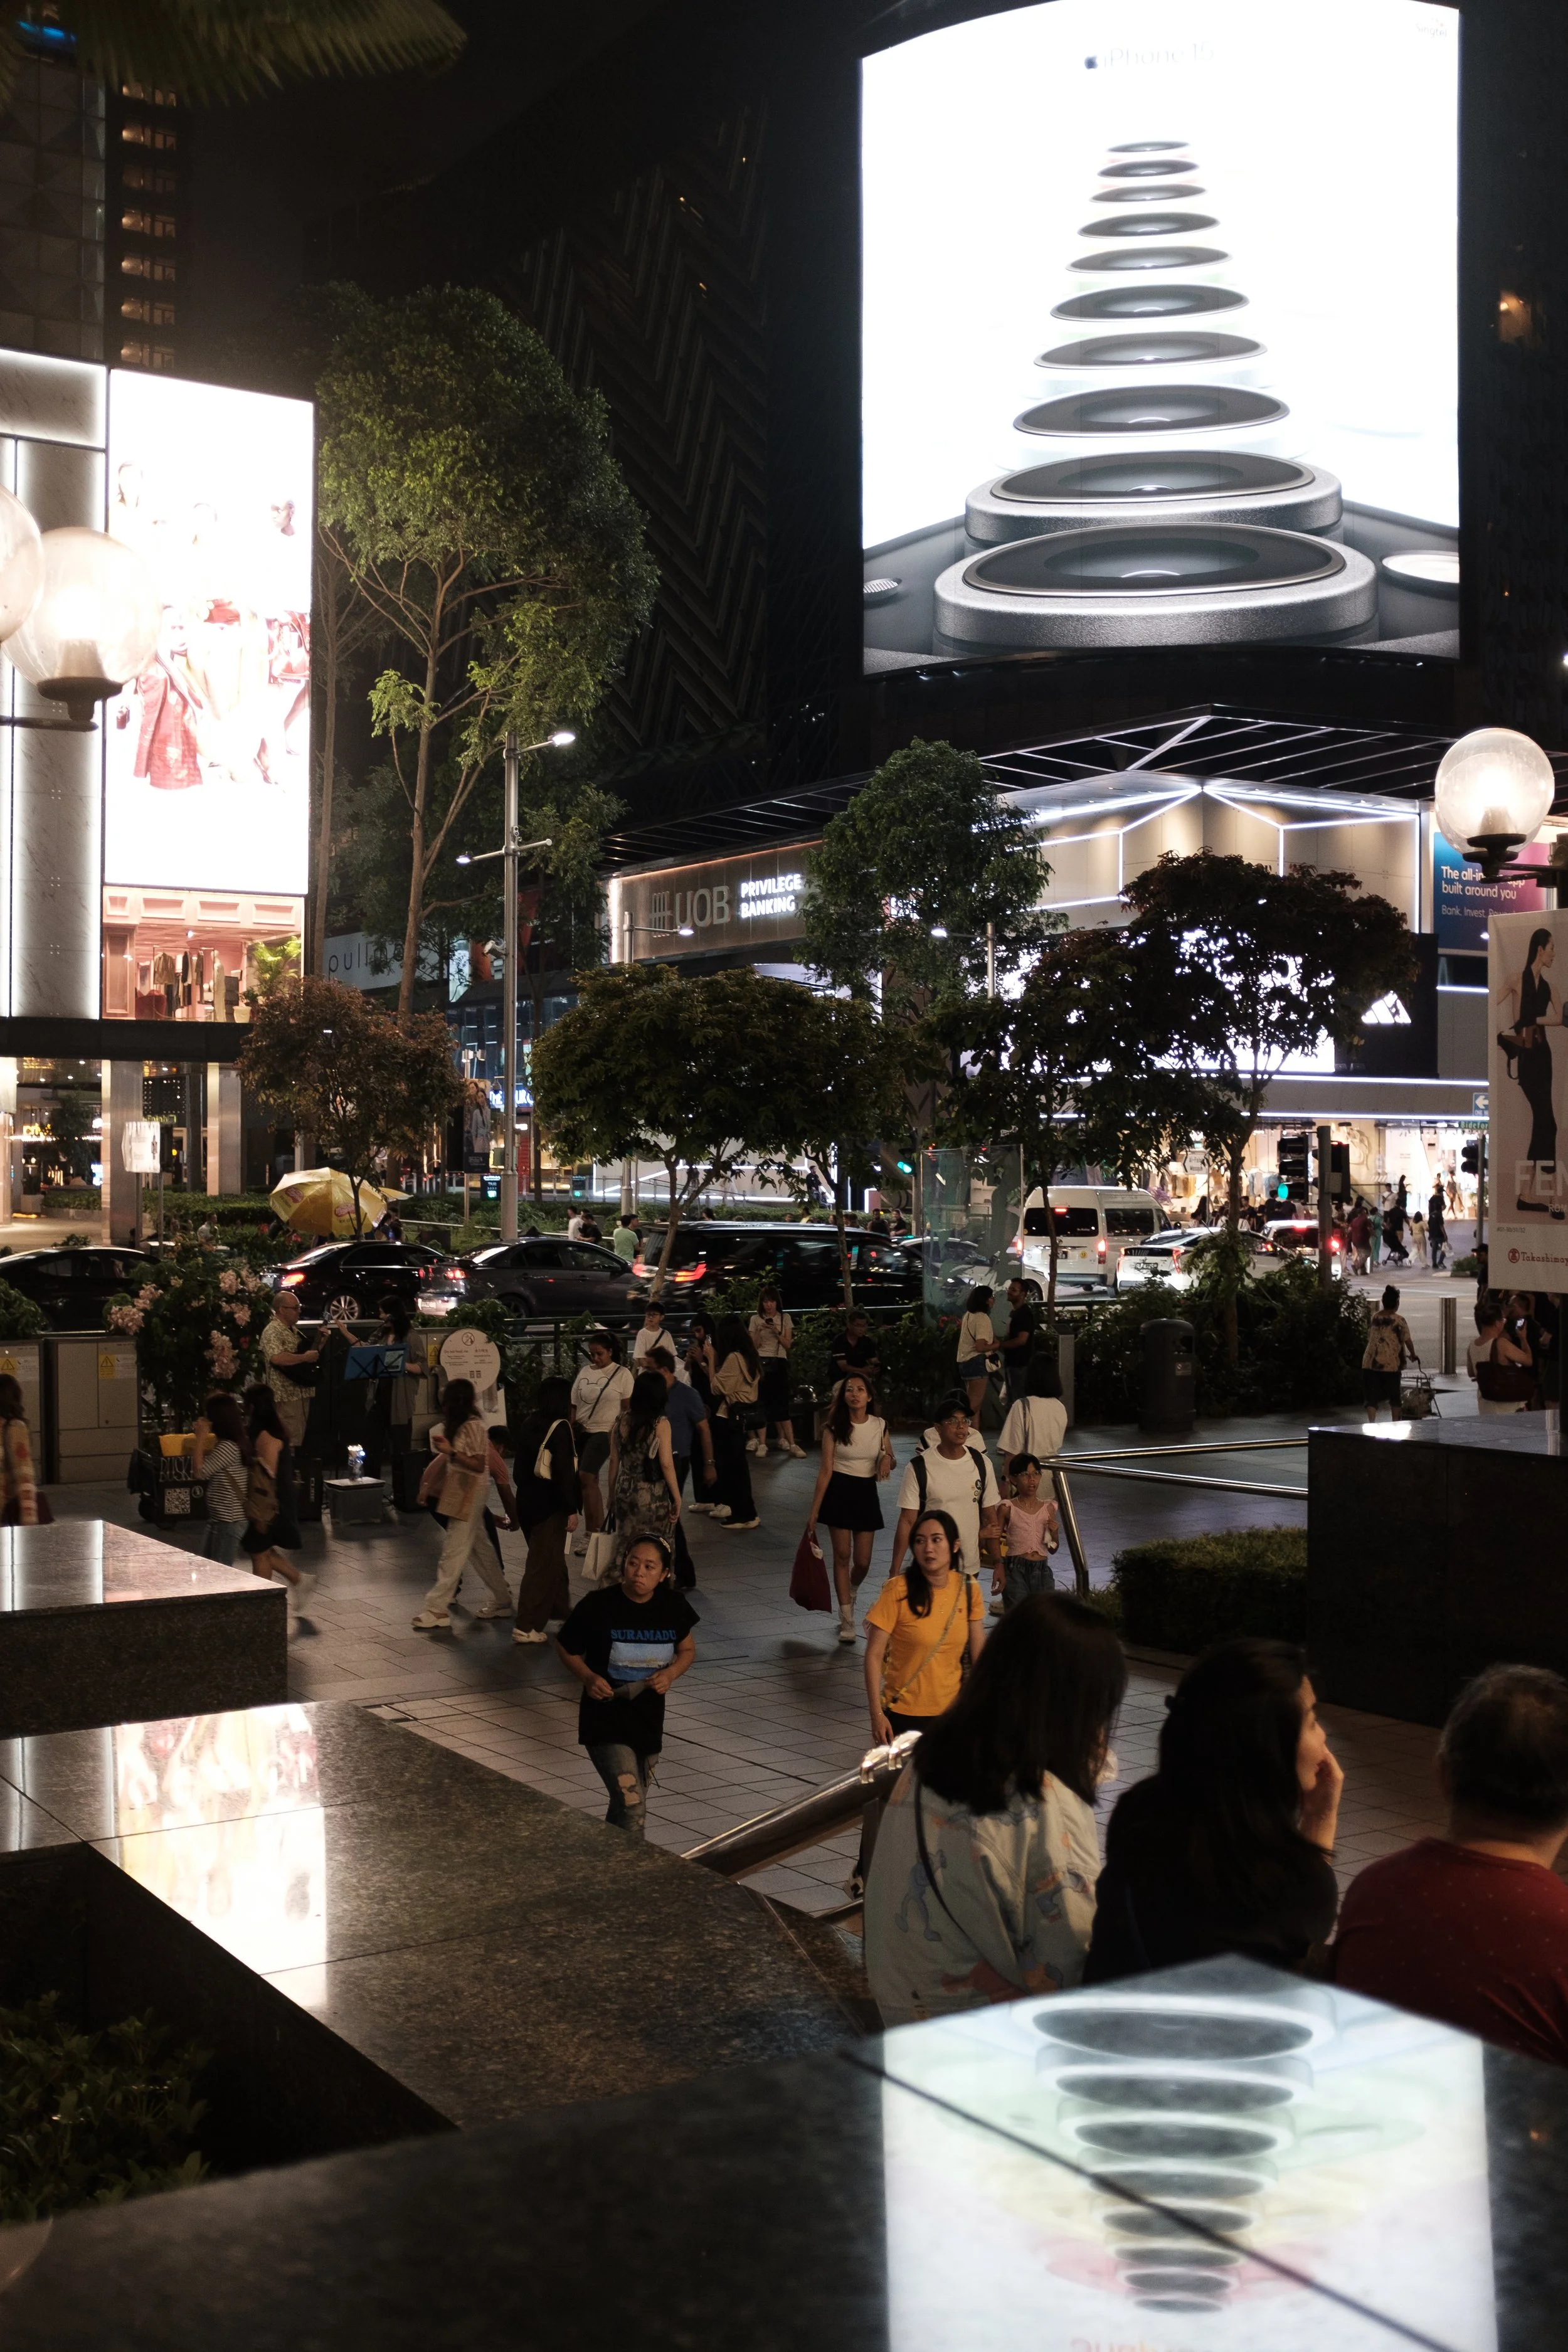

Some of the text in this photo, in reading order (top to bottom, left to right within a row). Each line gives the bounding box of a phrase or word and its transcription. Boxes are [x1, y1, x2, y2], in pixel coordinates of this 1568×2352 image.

[1104, 41, 1214, 68] iPhone 15
[1441, 866, 1459, 879] The
[740, 873, 803, 898] PRIVILEGE
[1442, 880, 1517, 901] built around you
[675, 885, 732, 929] UOB
[740, 894, 796, 919] BANKING
[1442, 904, 1463, 916] Bank.
[1465, 907, 1487, 918] Invest.
[611, 1629, 677, 1641] SURAMADU
